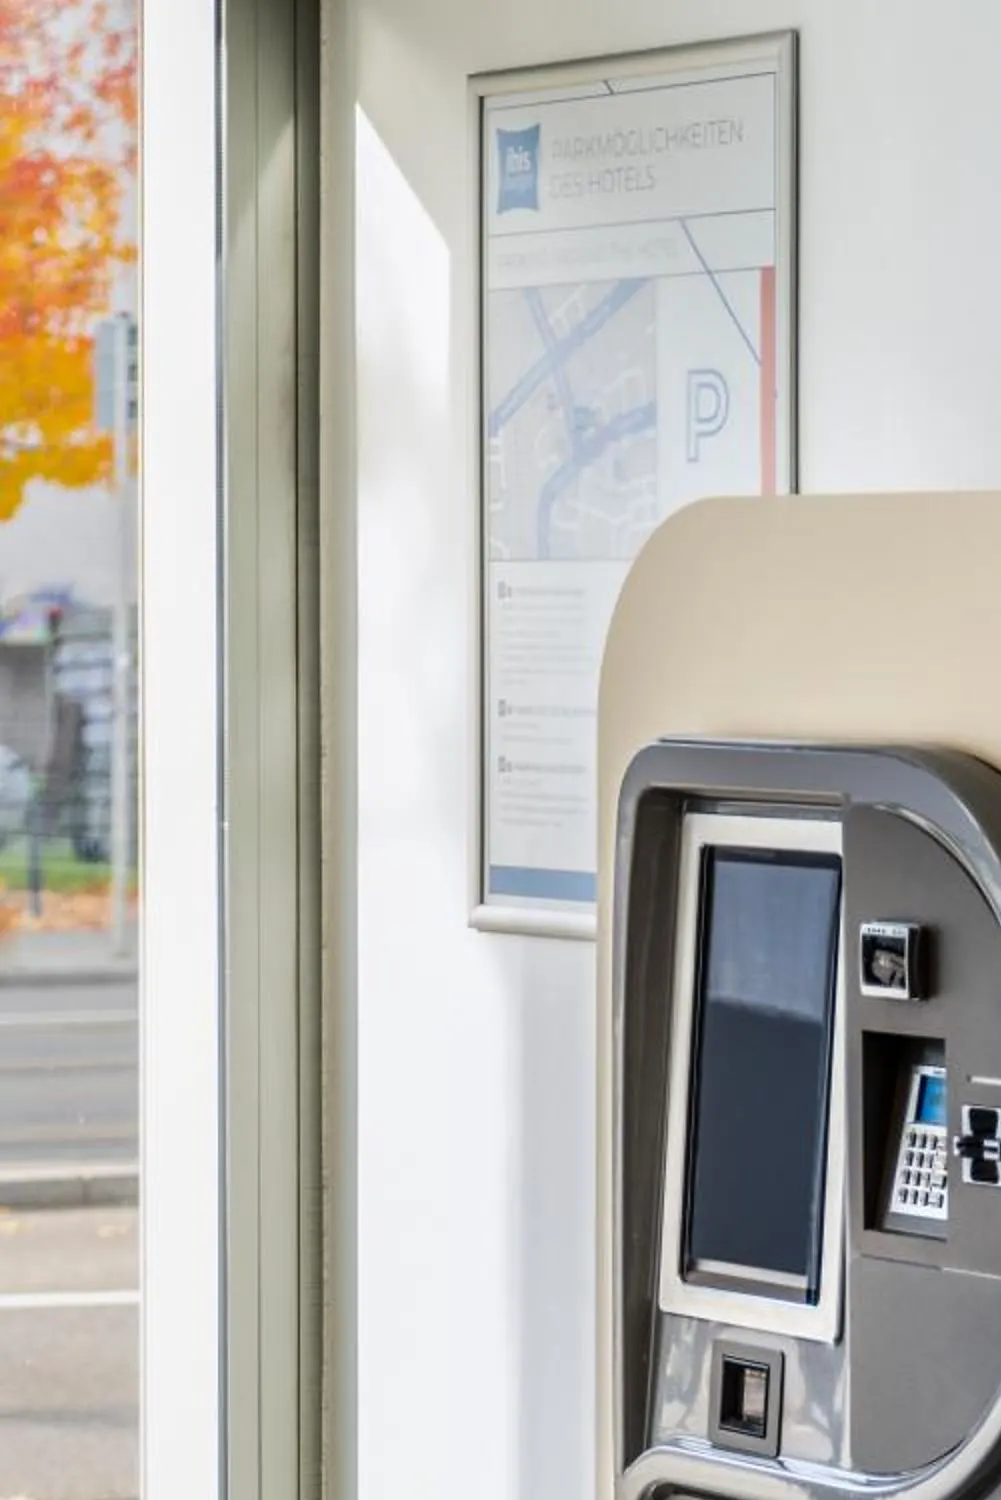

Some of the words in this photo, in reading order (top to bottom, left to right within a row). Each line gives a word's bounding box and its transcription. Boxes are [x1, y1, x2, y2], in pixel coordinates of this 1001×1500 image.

[505, 144, 532, 173] ibis
[550, 173, 584, 198] DES
[588, 165, 656, 194] HOTELS
[687, 369, 730, 463] P
